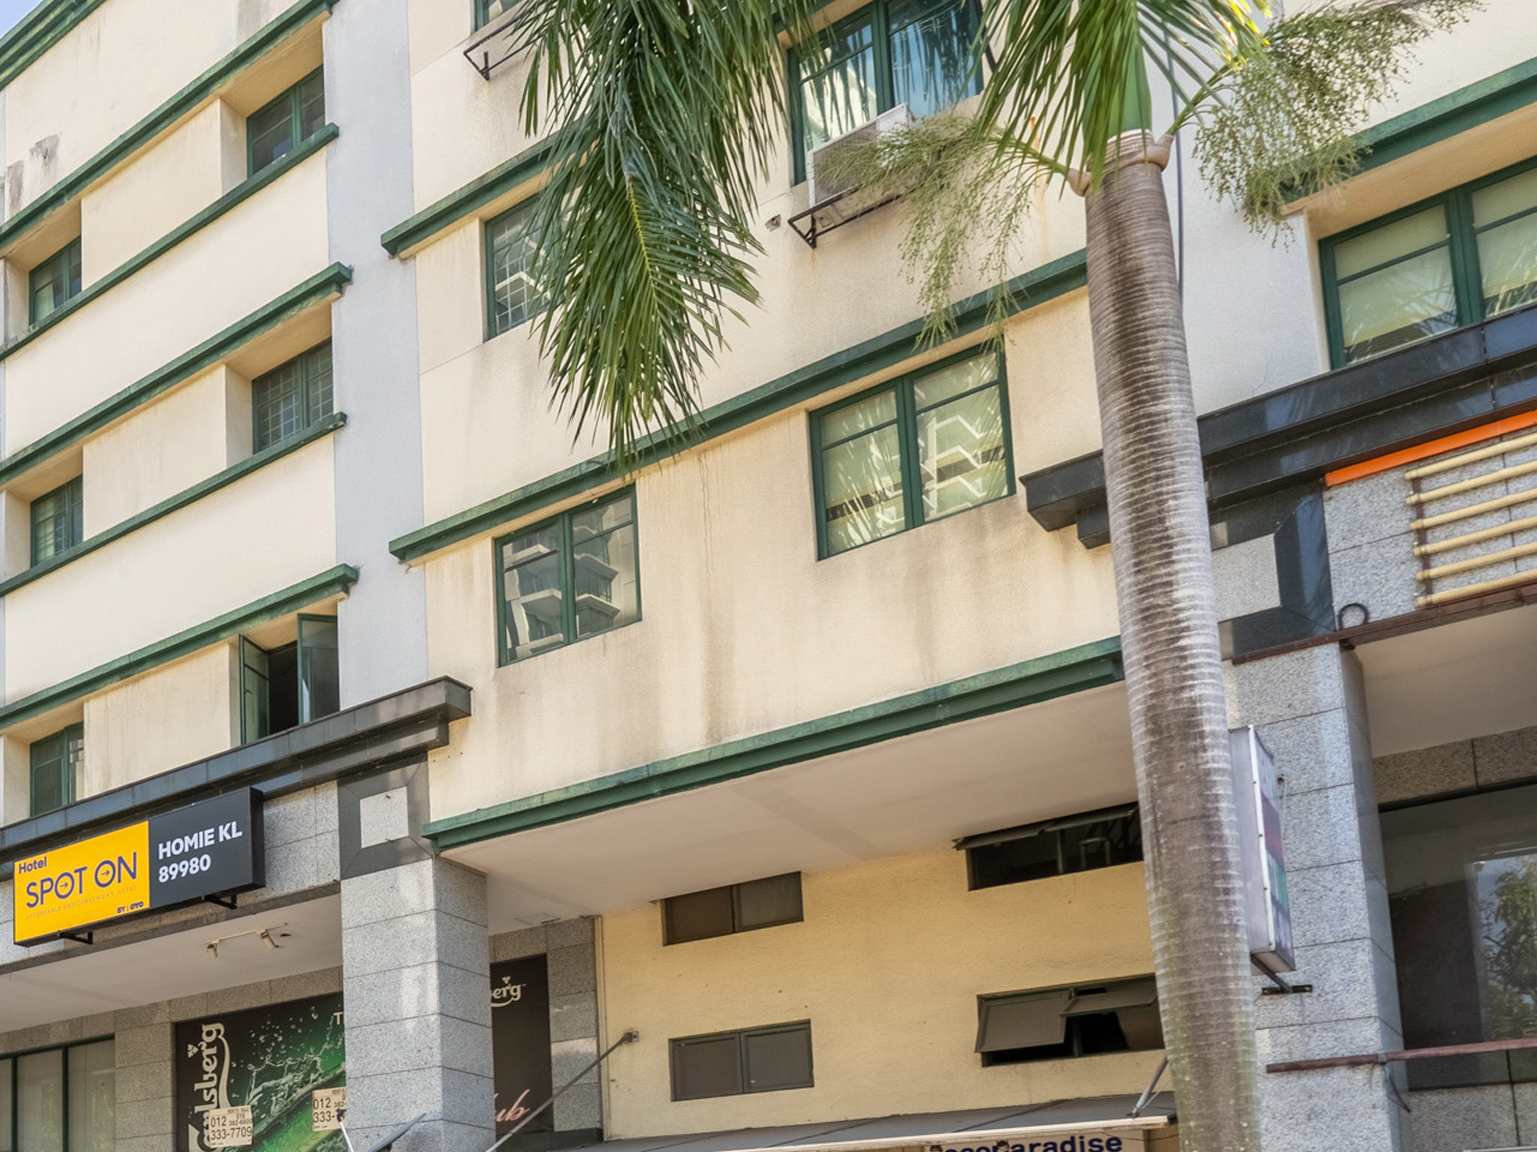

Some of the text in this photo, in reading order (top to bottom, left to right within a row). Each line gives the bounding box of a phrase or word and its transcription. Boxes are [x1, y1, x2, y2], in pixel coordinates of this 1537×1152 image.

[158, 821, 243, 860] HOMIE KL
[18, 856, 48, 875] Hotel
[158, 853, 212, 883] 89980
[26, 851, 137, 908] SPOT ON
[313, 1097, 331, 1110] 012
[210, 1115, 227, 1128] 012
[210, 1126, 252, 1141] 333-7709
